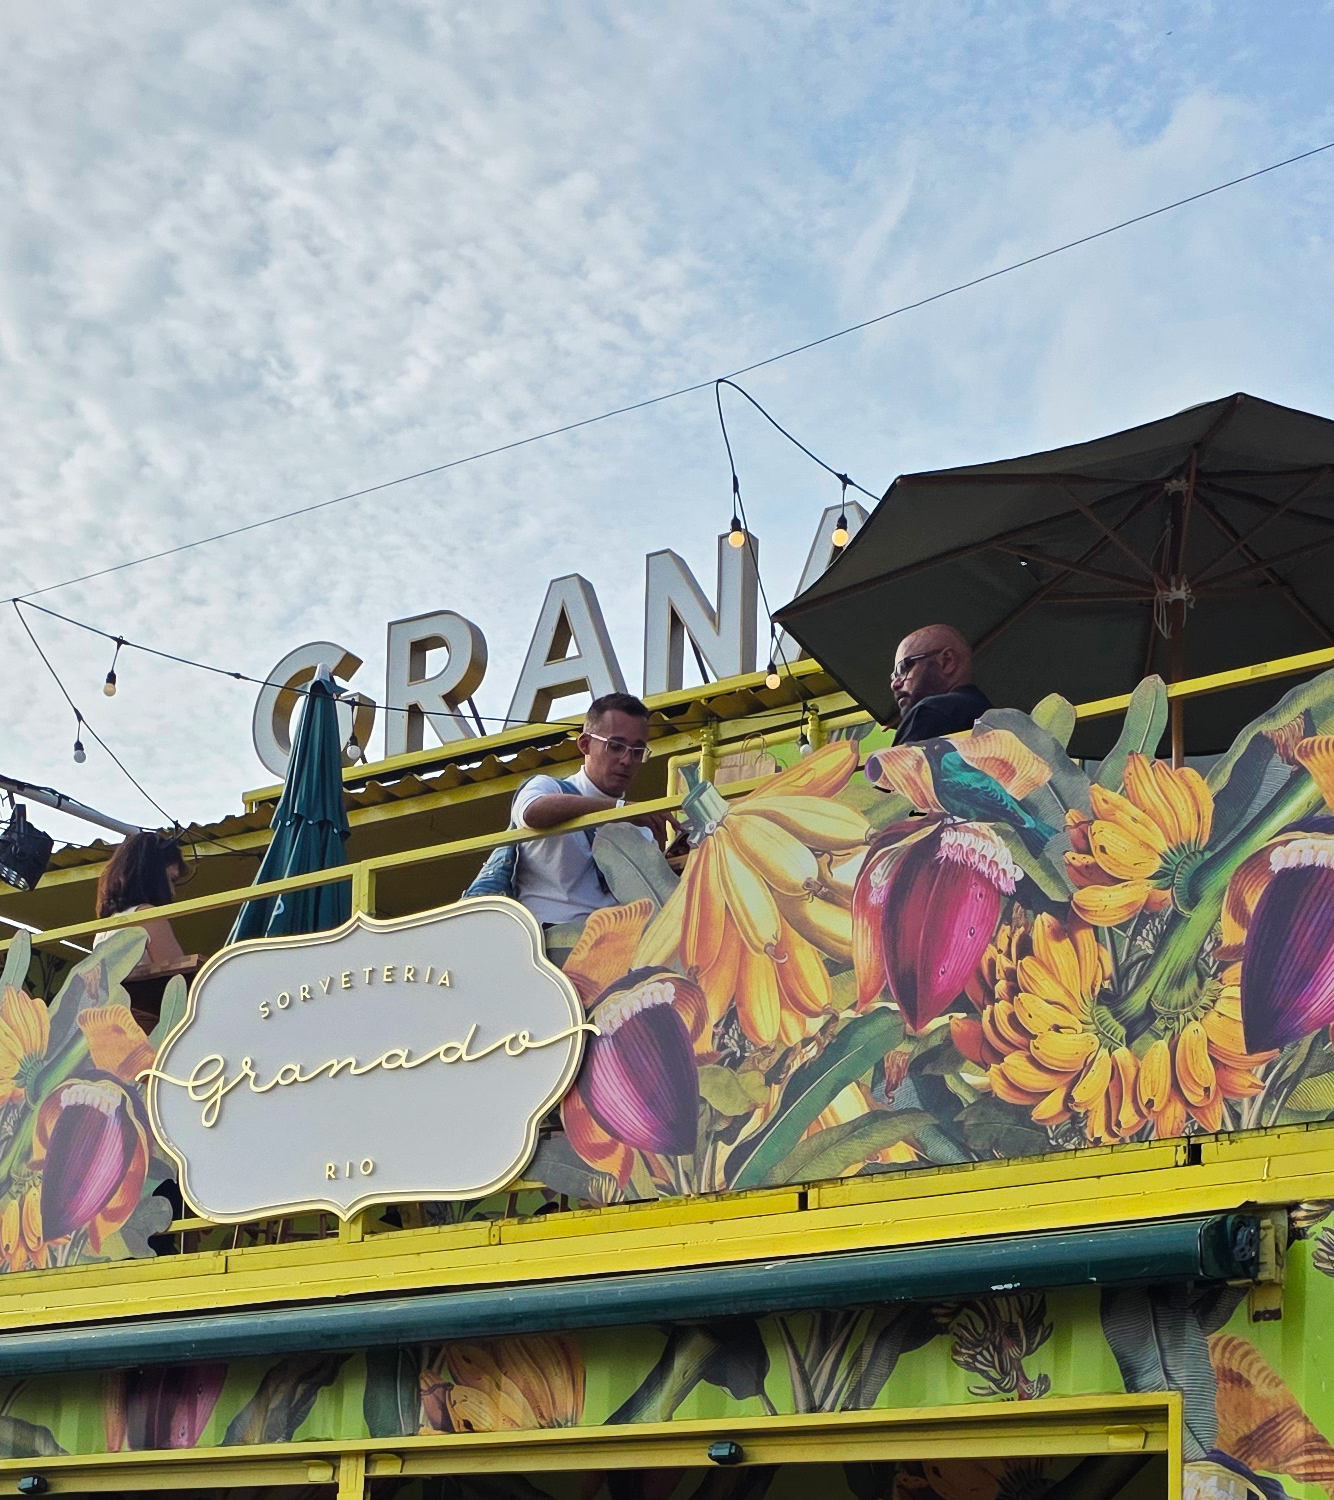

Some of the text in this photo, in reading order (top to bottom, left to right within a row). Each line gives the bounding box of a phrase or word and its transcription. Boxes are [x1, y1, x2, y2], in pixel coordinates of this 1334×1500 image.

[258, 965, 451, 1018] SORVETERIA
[135, 1024, 601, 1127] Granado
[325, 1158, 374, 1179] RIO
